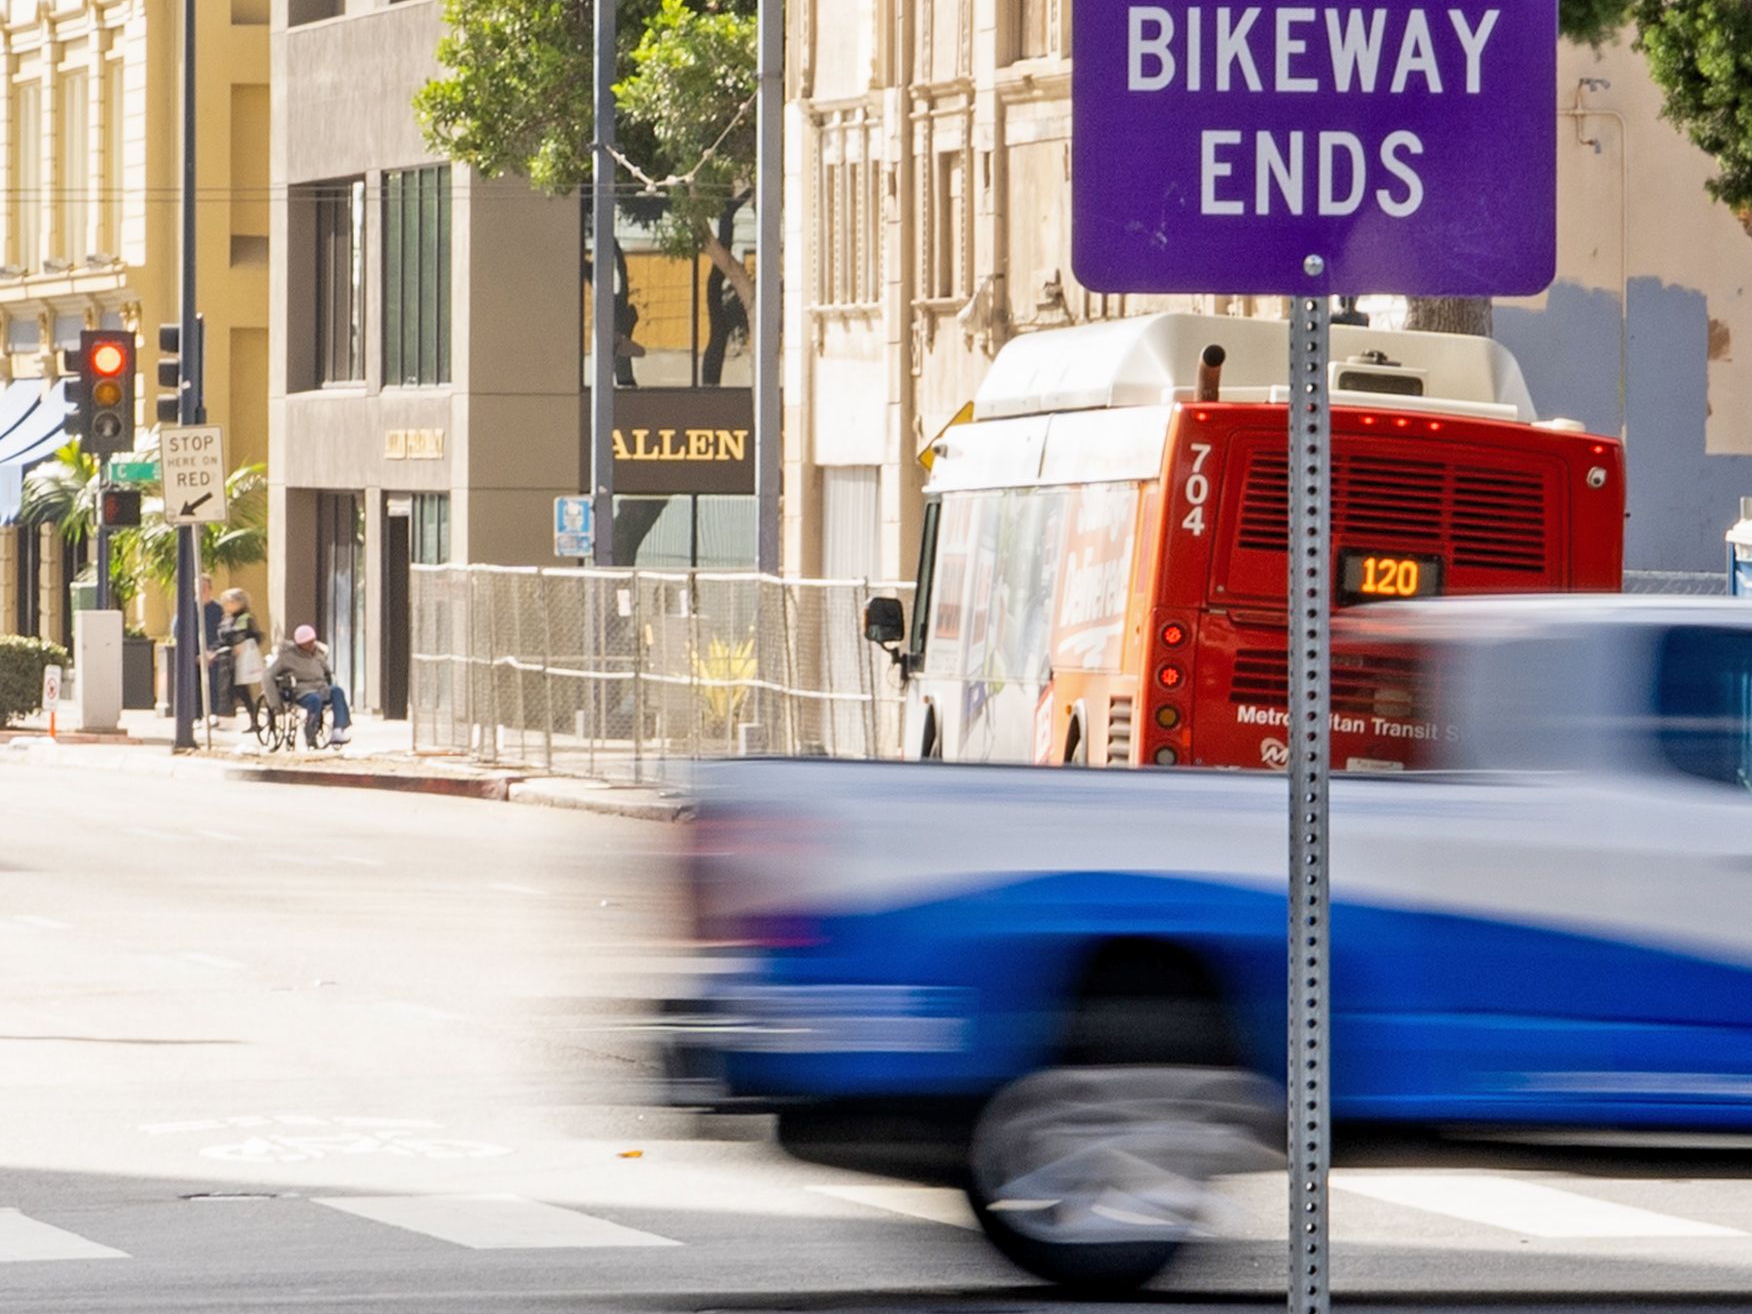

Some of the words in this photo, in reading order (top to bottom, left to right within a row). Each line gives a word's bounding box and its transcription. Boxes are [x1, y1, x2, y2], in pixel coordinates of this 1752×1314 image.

[1127, 6, 1501, 94] BIKEWAY
[1200, 130, 1425, 218] ENDS
[169, 435, 214, 452] STOP
[613, 429, 748, 460] ALLEN
[167, 458, 196, 468] HERE
[202, 456, 218, 466] ON
[177, 471, 211, 486] RED
[1180, 443, 1212, 537] 704
[1361, 559, 1420, 598] 120
[1237, 704, 1365, 734] Metroitan
[1371, 717, 1438, 740] Transit
